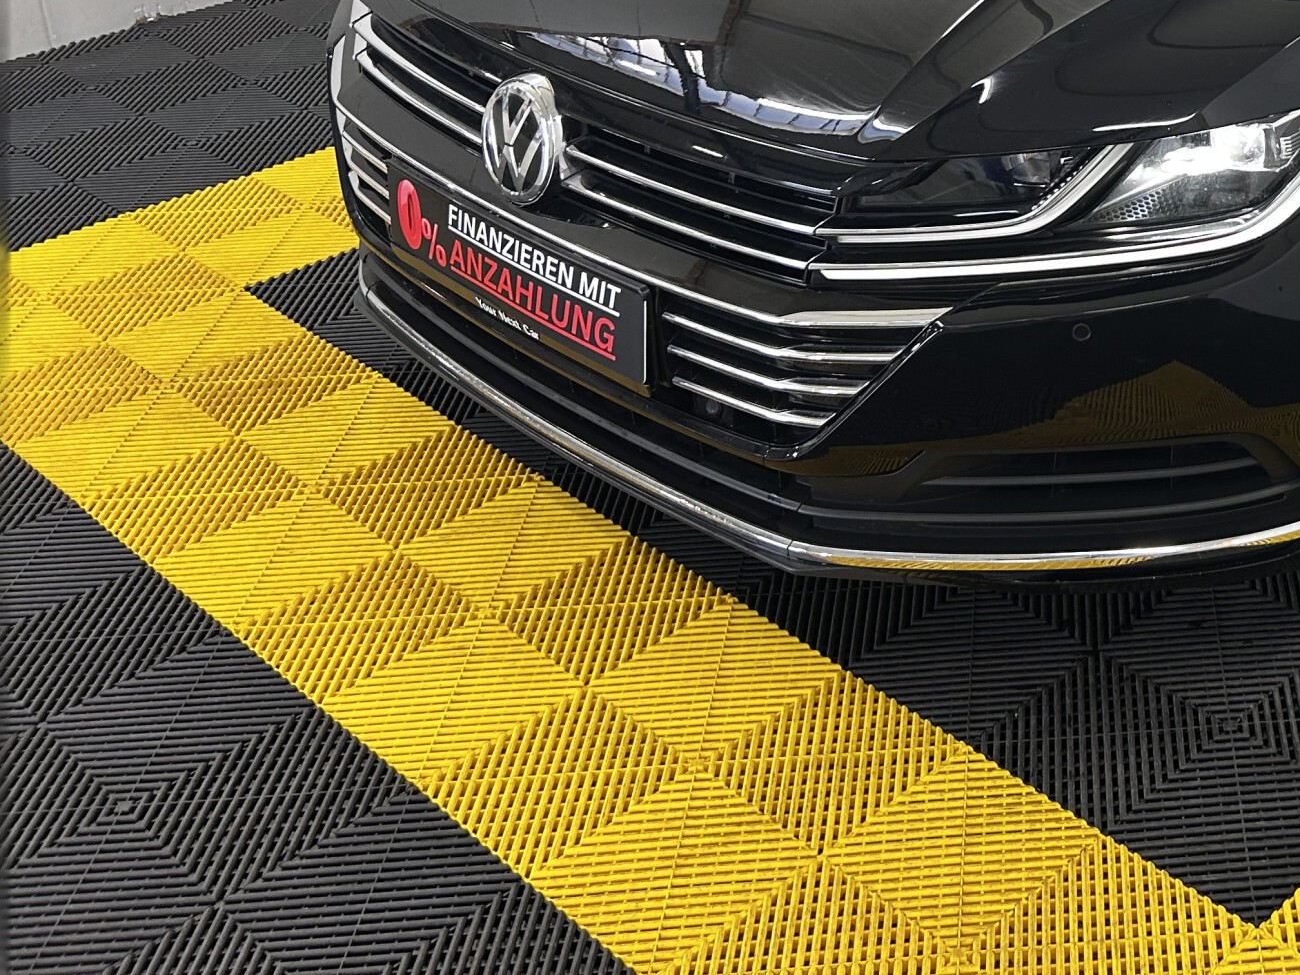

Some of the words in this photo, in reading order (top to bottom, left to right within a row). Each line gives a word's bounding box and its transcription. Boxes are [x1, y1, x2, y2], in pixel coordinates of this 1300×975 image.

[483, 77, 553, 202] VW
[397, 179, 447, 267] 0%
[449, 239, 616, 353] ANZAHLUNG
[448, 204, 573, 289] FINANZIEREN
[579, 271, 621, 309] MIT
[475, 296, 497, 316] Your
[498, 309, 522, 331] Next
[522, 324, 539, 340] Car
